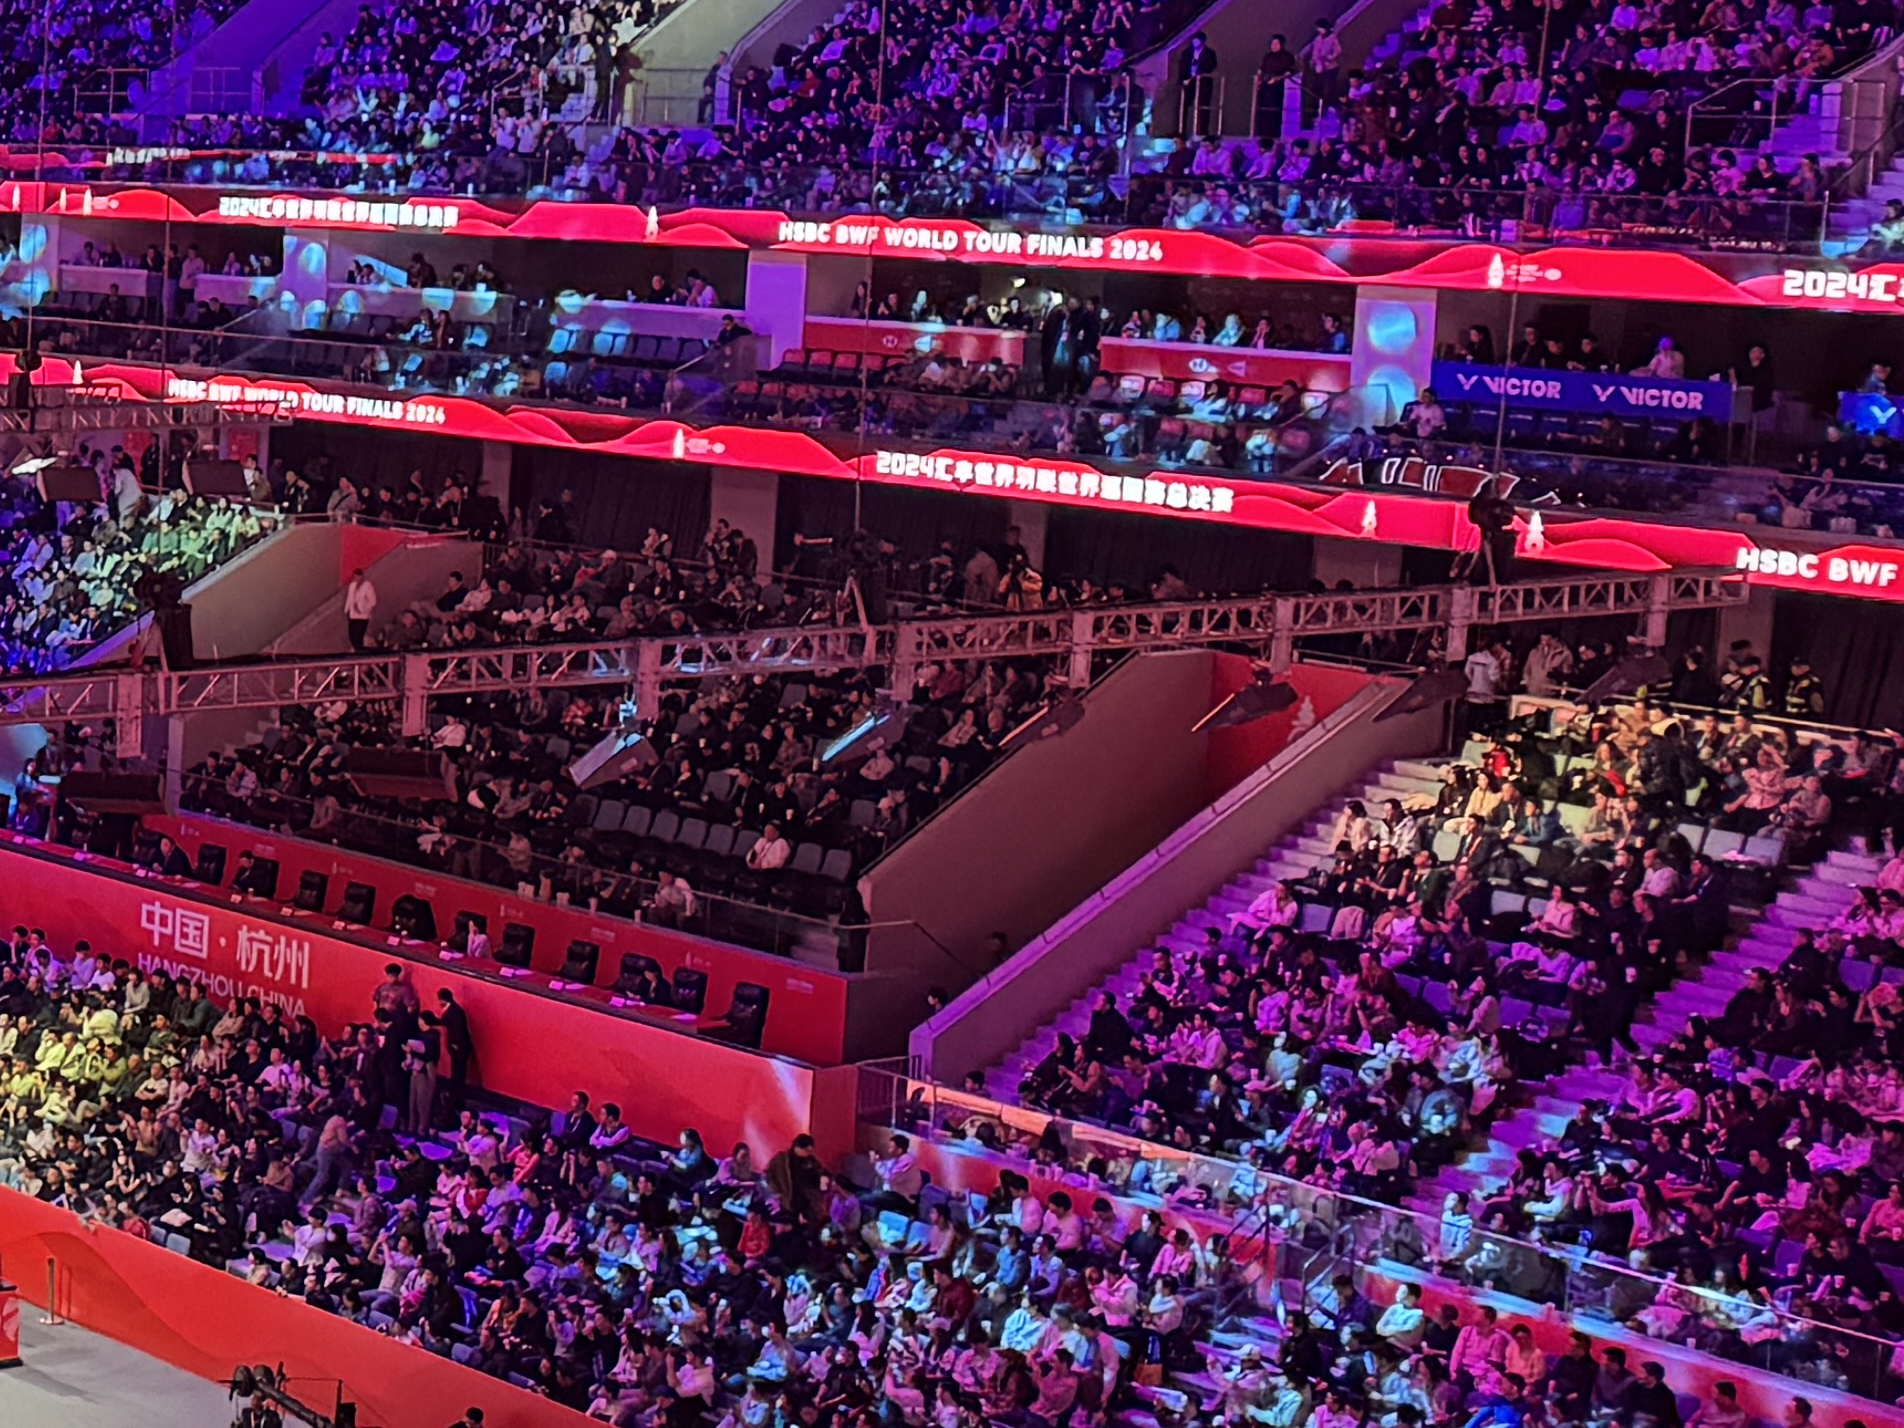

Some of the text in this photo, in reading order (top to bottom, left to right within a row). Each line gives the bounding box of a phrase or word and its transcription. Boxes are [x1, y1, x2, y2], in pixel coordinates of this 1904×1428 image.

[779, 221, 1163, 262] HSBC BWF WORLD TOUR FINALS 2024
[1782, 269, 1904, 303] 2024汇
[1483, 375, 1562, 400] VICTOR
[1618, 385, 1704, 411] VICTOR
[301, 391, 348, 414] TOUR
[348, 396, 404, 420] FINALS
[405, 402, 447, 424] 2024
[1735, 546, 1898, 587] HSBC BWF
[140, 900, 311, 990] 中国·杭州
